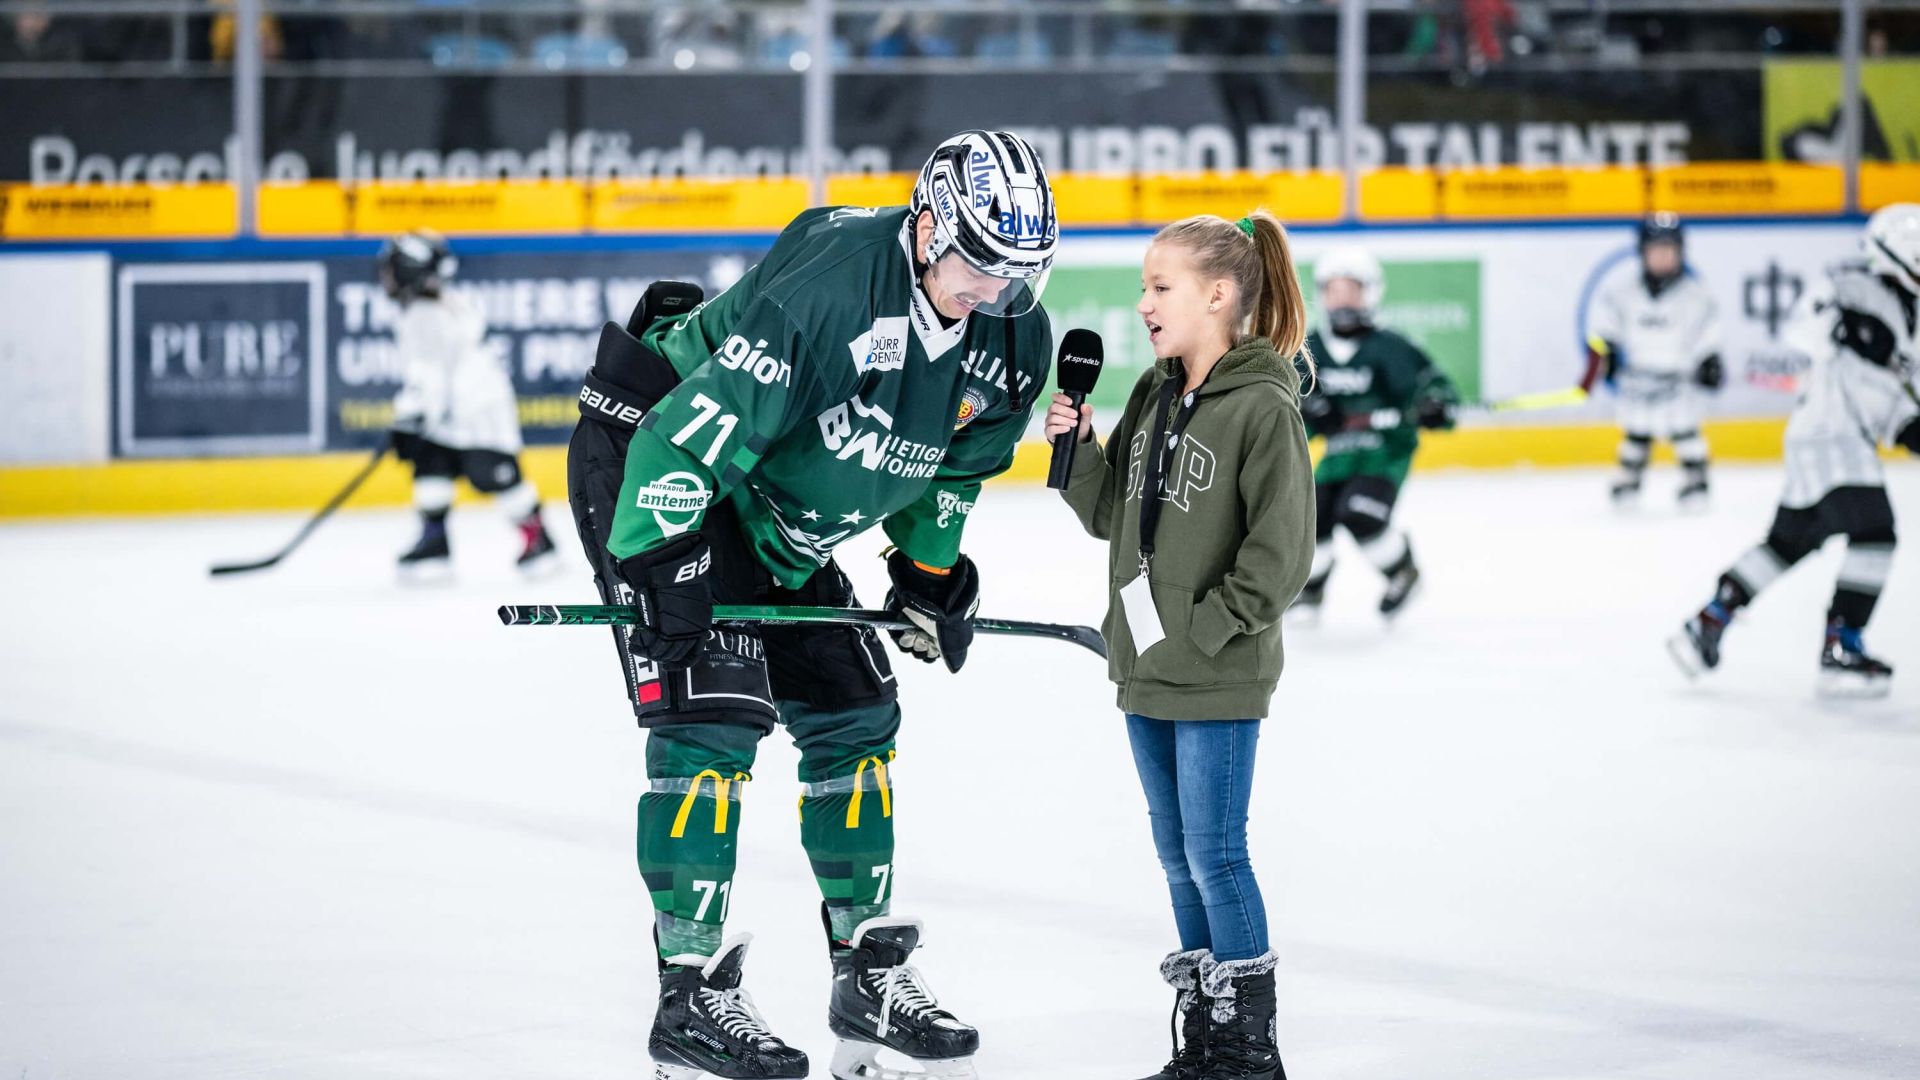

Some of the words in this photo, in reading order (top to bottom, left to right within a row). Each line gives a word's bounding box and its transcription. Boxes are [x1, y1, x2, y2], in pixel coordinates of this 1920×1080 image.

[971, 151, 996, 209] alwa
[936, 184, 954, 221] alwa
[151, 320, 300, 380] PURE
[713, 333, 792, 388] gion
[579, 385, 648, 427] BAUE
[670, 392, 740, 467] 71
[651, 483, 685, 493] HITRADIO
[1125, 430, 1216, 513] GP
[640, 493, 704, 508] antenne
[692, 879, 731, 923] 71
[691, 1029, 726, 1050] BAUER
